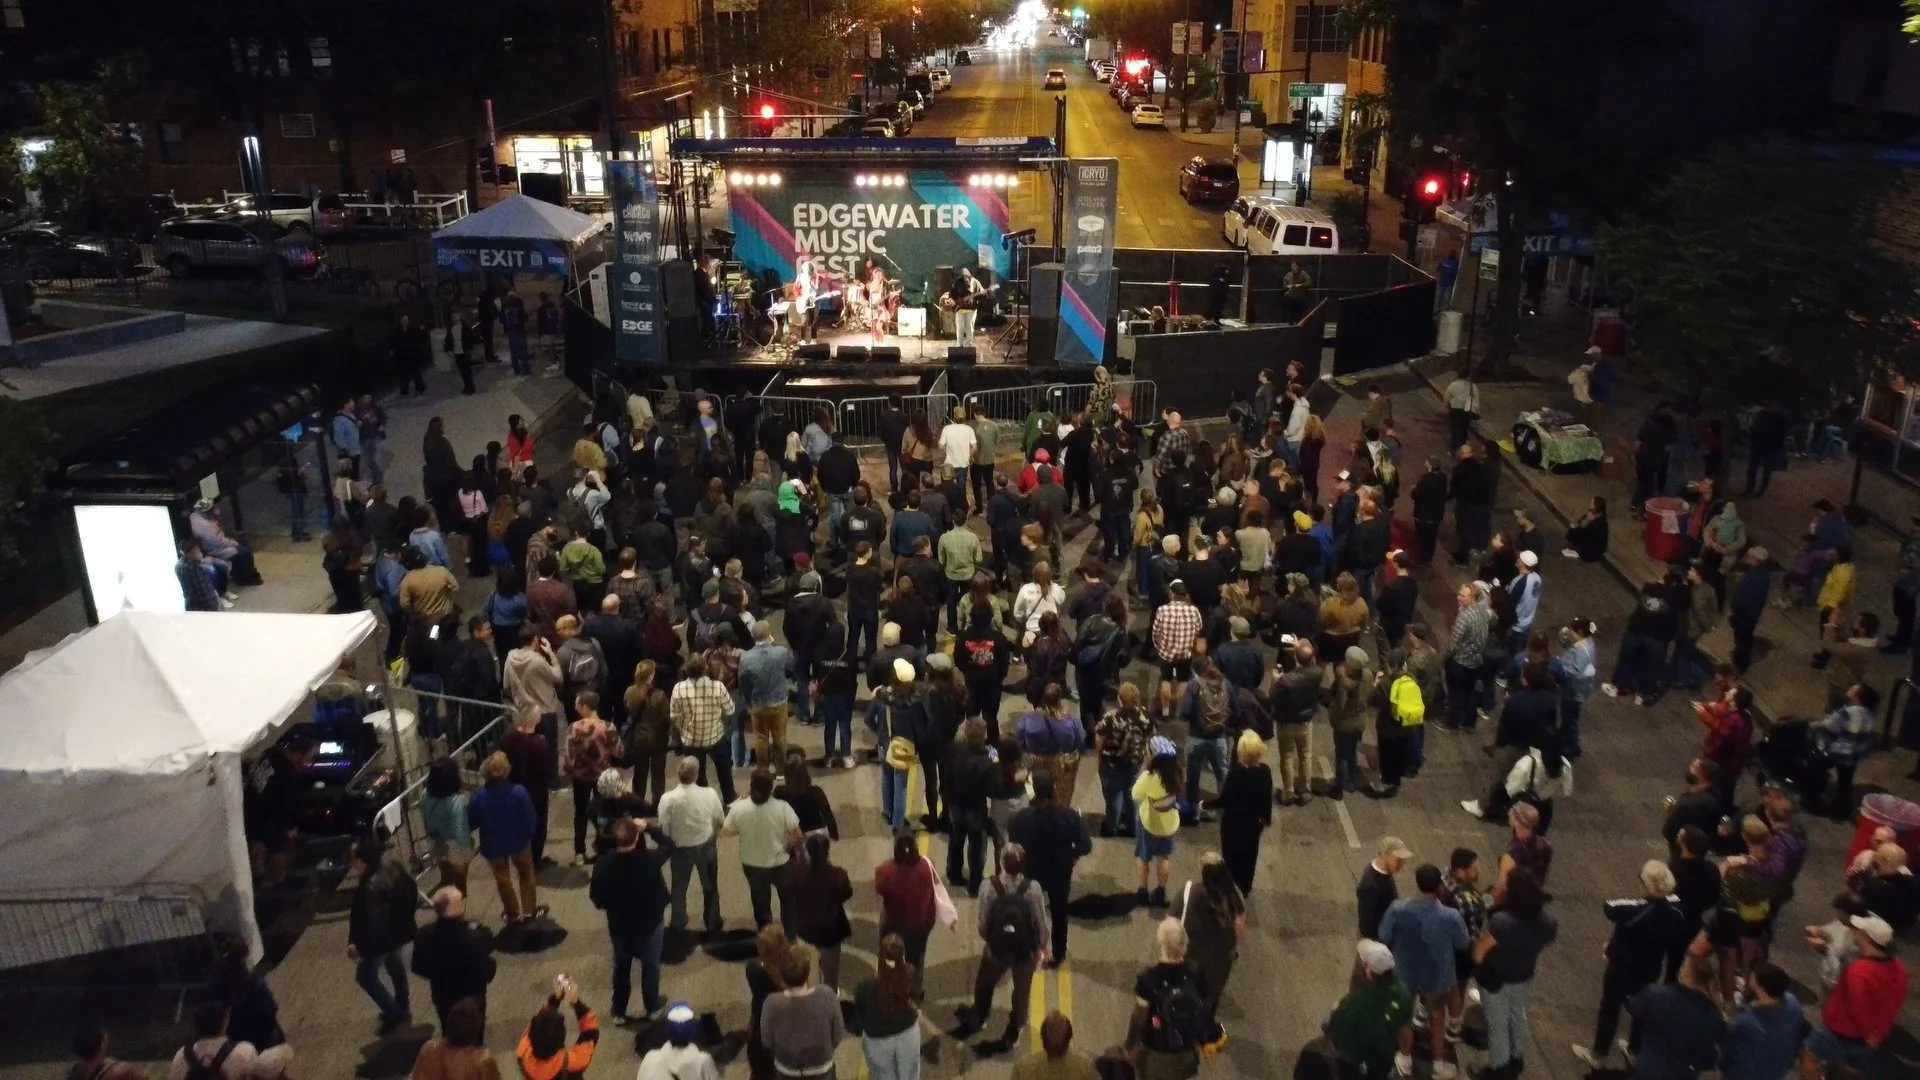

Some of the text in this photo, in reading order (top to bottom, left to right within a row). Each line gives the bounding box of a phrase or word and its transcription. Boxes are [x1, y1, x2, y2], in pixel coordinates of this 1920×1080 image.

[793, 203, 972, 228] EDGEWATER
[795, 229, 887, 254] MUSIC
[1522, 235, 1557, 252] XIT
[479, 249, 524, 268] EXIT
[622, 319, 653, 331] EDGE
